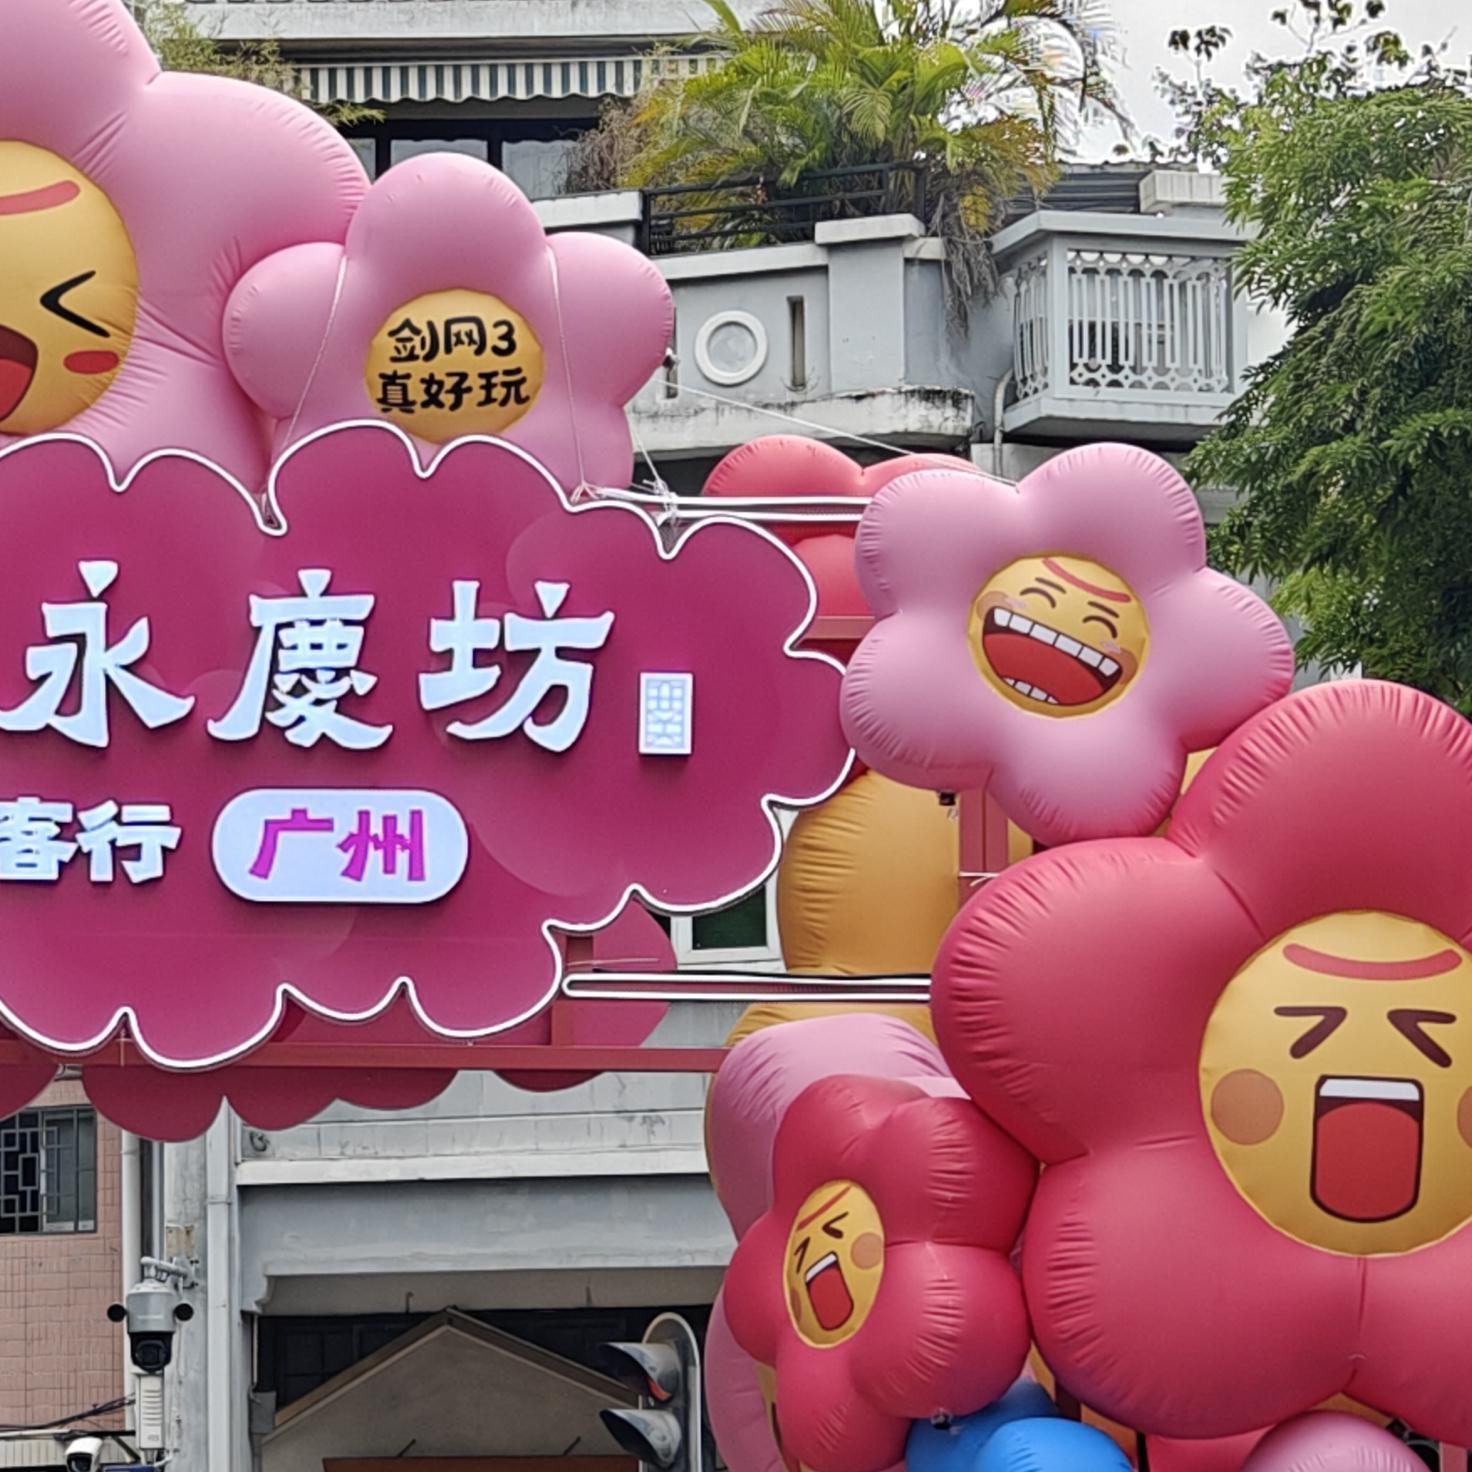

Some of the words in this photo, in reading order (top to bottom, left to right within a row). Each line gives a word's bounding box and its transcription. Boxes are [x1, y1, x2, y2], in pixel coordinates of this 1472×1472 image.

[387, 315, 519, 364] 剑网3
[374, 367, 532, 415] 真好玩
[248, 806, 427, 884] 广州
